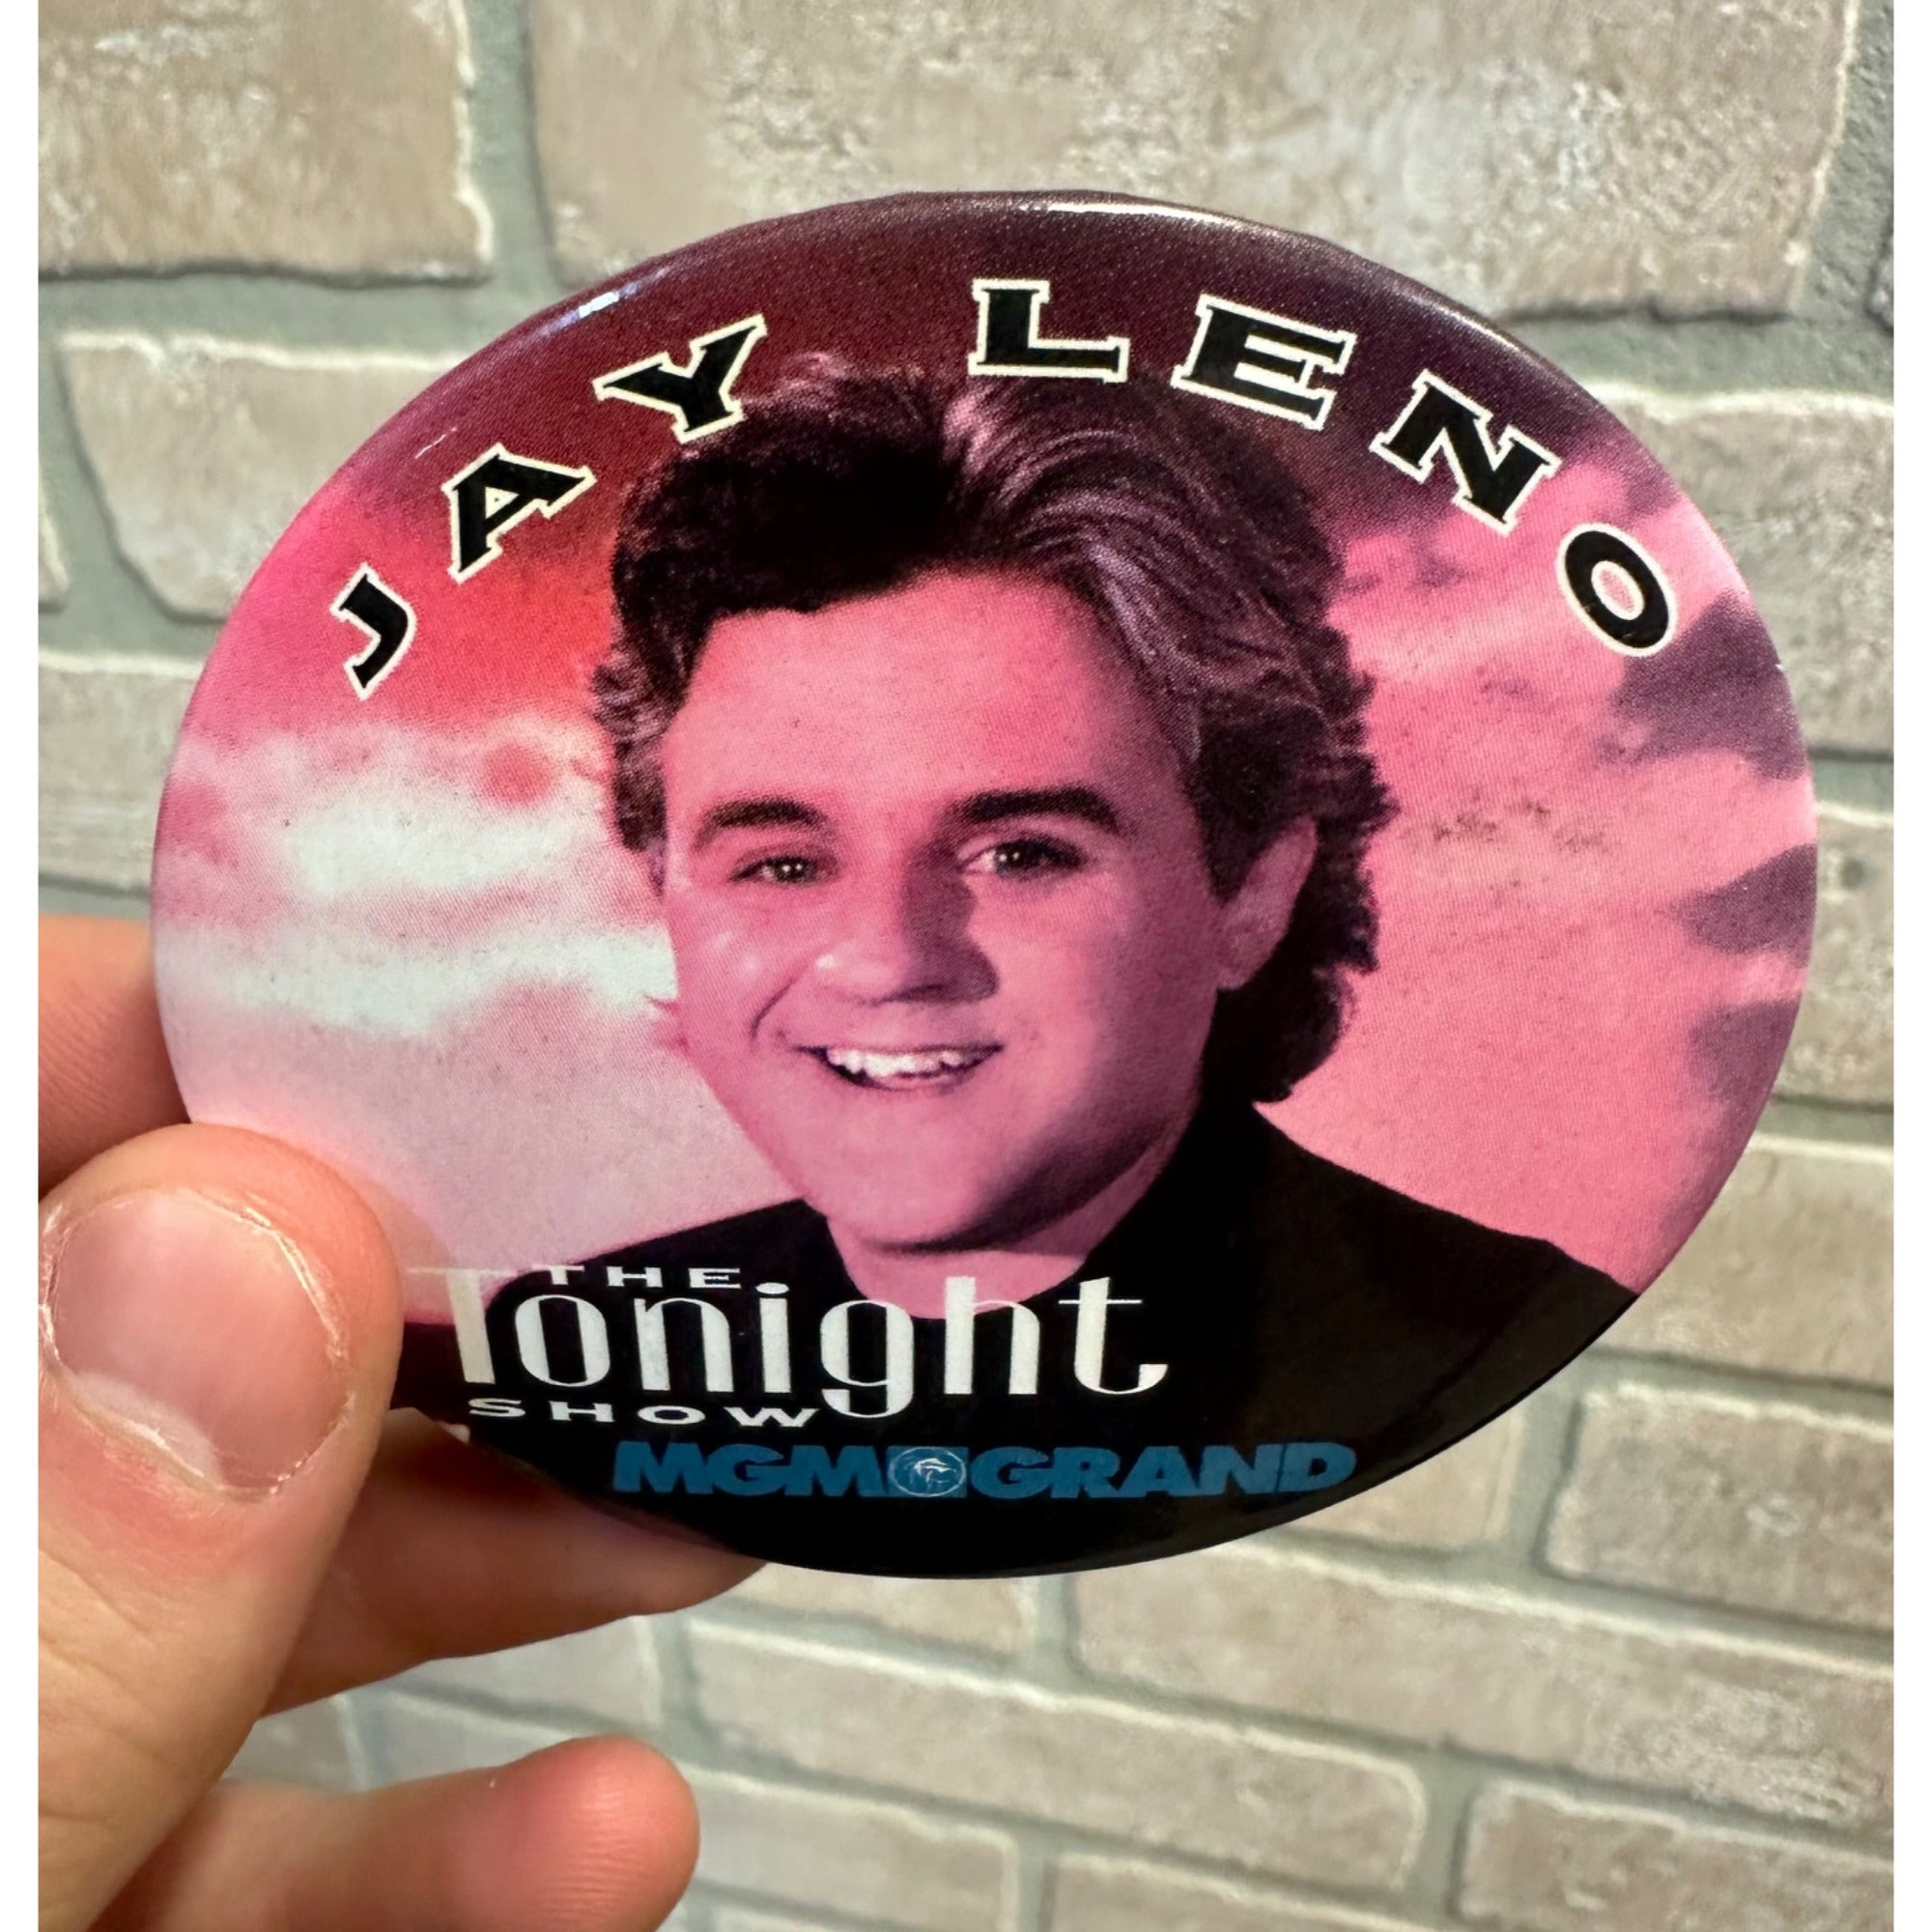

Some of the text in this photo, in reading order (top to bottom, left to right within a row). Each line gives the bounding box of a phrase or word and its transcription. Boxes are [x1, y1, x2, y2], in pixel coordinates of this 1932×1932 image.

[330, 277, 1678, 700] JAY LENO
[531, 1264, 742, 1290] THE
[406, 1266, 1169, 1418] Tonight
[468, 1397, 821, 1428] SHOW
[612, 1439, 1357, 1498] MGM GRAND
